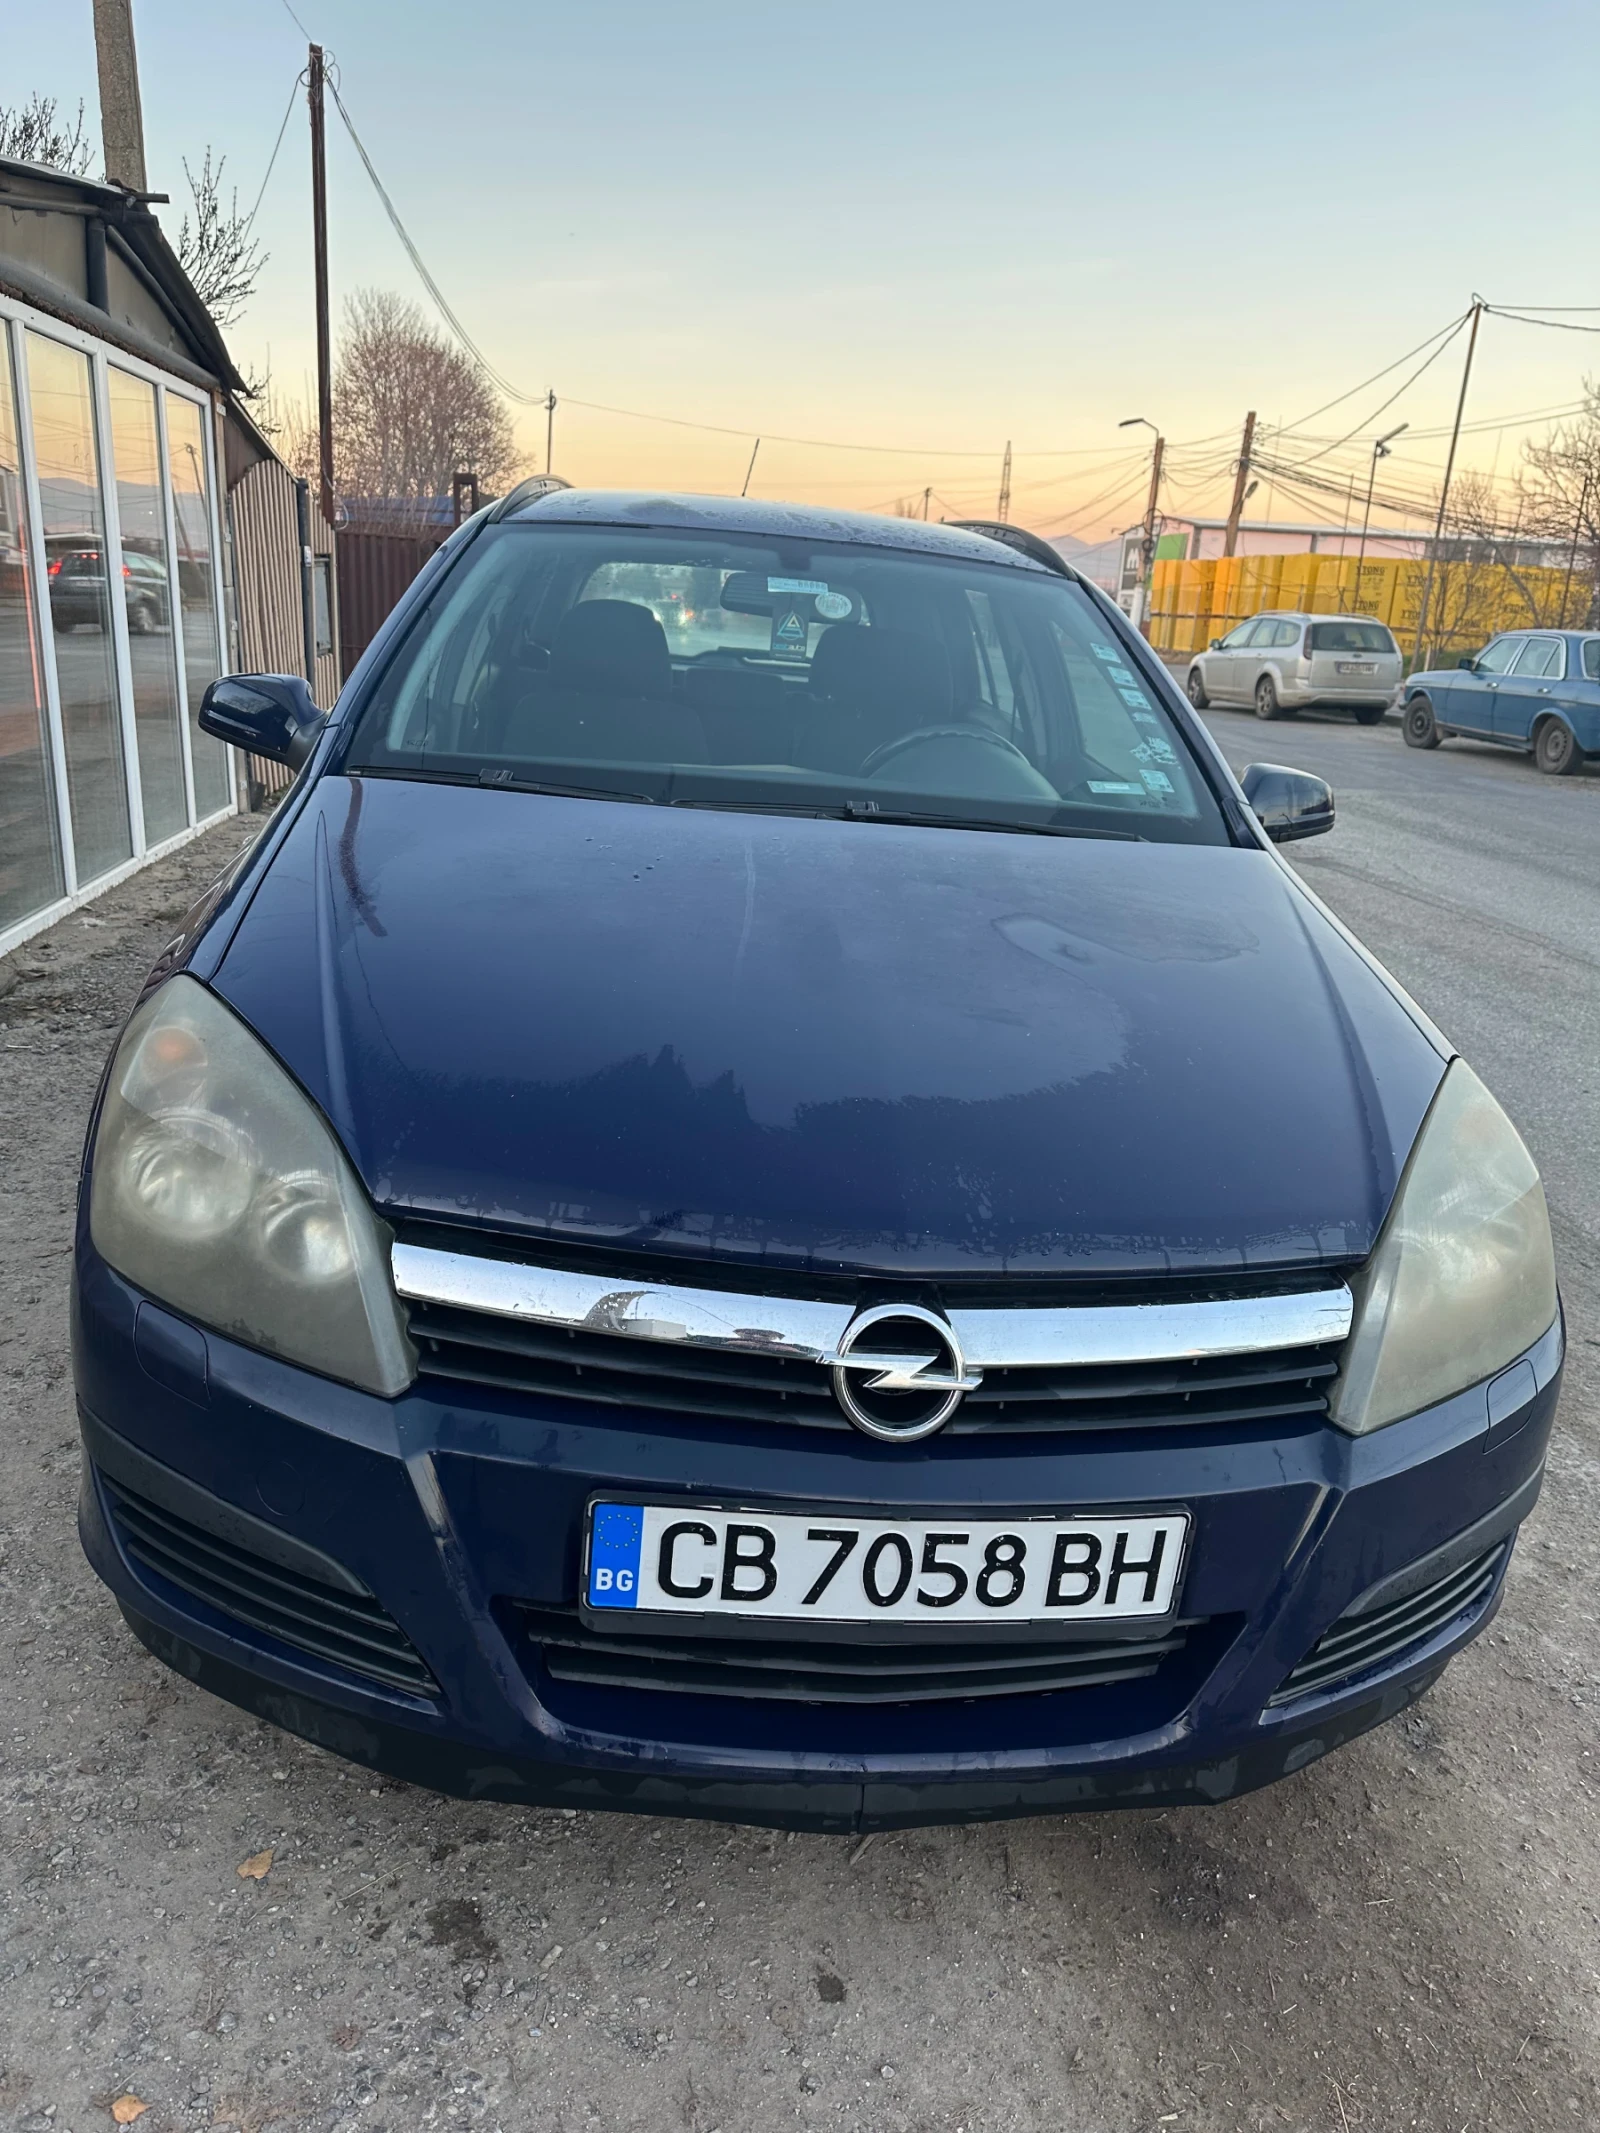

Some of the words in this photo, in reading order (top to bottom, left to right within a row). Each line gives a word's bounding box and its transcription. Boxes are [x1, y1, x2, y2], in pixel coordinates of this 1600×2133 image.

[595, 1567, 634, 1592] BG
[657, 1520, 778, 1602] CB
[800, 1529, 1026, 1608] 7058
[1043, 1529, 1168, 1608] BH
